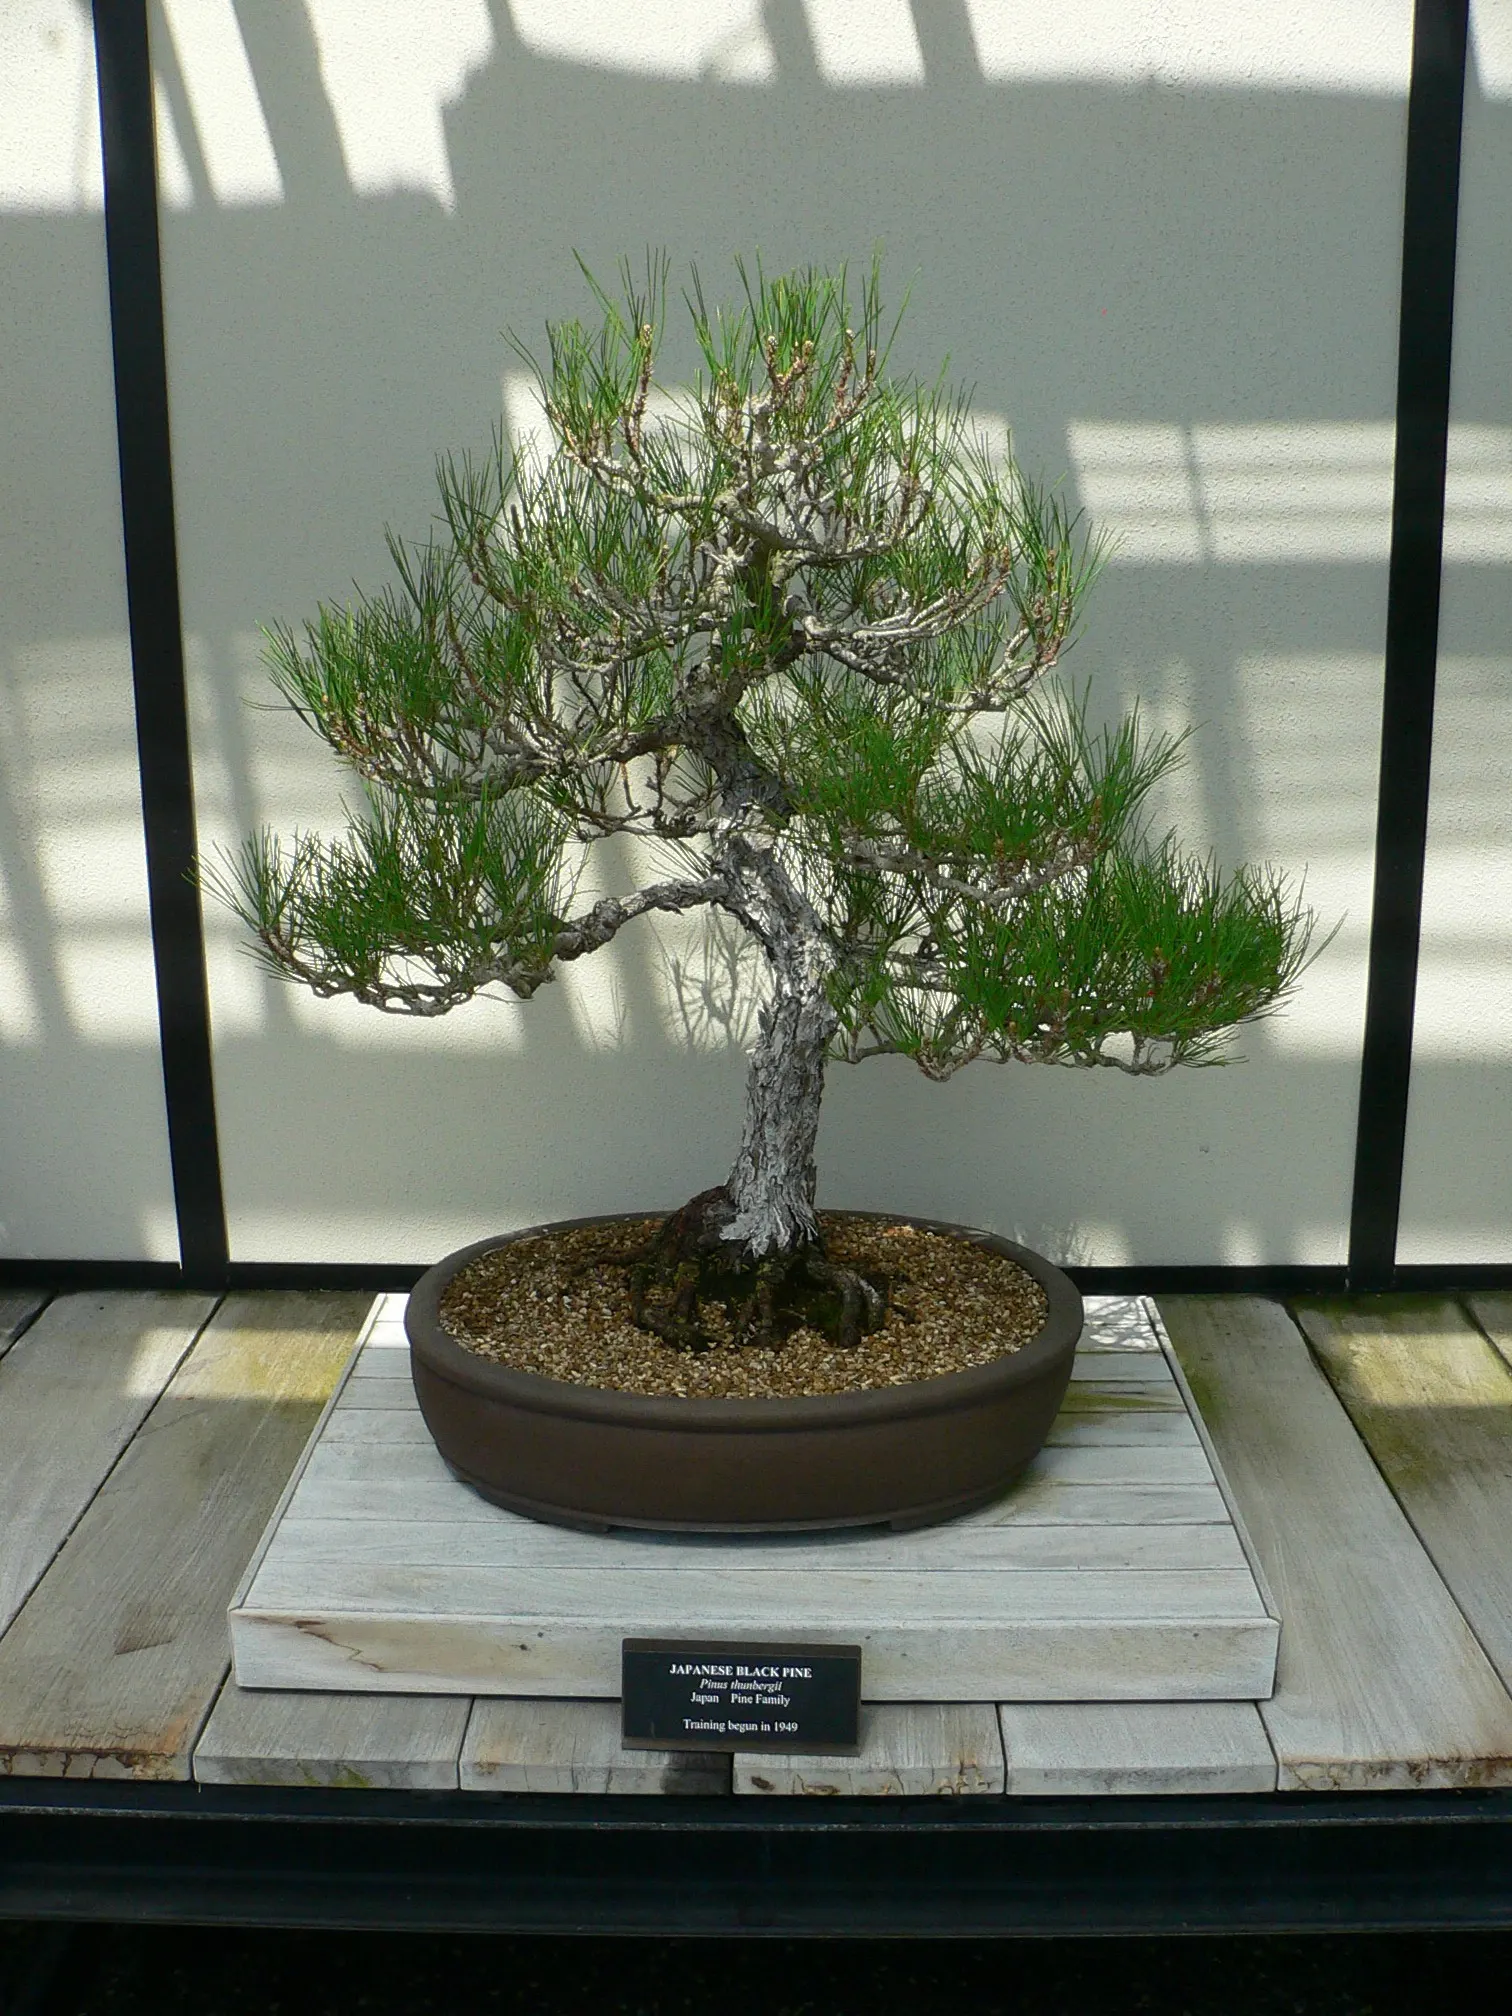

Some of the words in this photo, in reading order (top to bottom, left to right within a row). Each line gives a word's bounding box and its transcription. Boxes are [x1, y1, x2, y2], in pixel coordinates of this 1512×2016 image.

[669, 1664, 734, 1676] JAPANESE
[736, 1666, 780, 1677] BLACK
[782, 1667, 812, 1678] PINE
[699, 1679, 728, 1690] Pinus
[690, 1692, 720, 1704] Japan
[730, 1693, 753, 1704] Pine
[755, 1694, 791, 1707] Family
[683, 1719, 726, 1733] Training
[728, 1720, 758, 1733] begun
[760, 1721, 771, 1732] in
[774, 1722, 799, 1732] 1949
